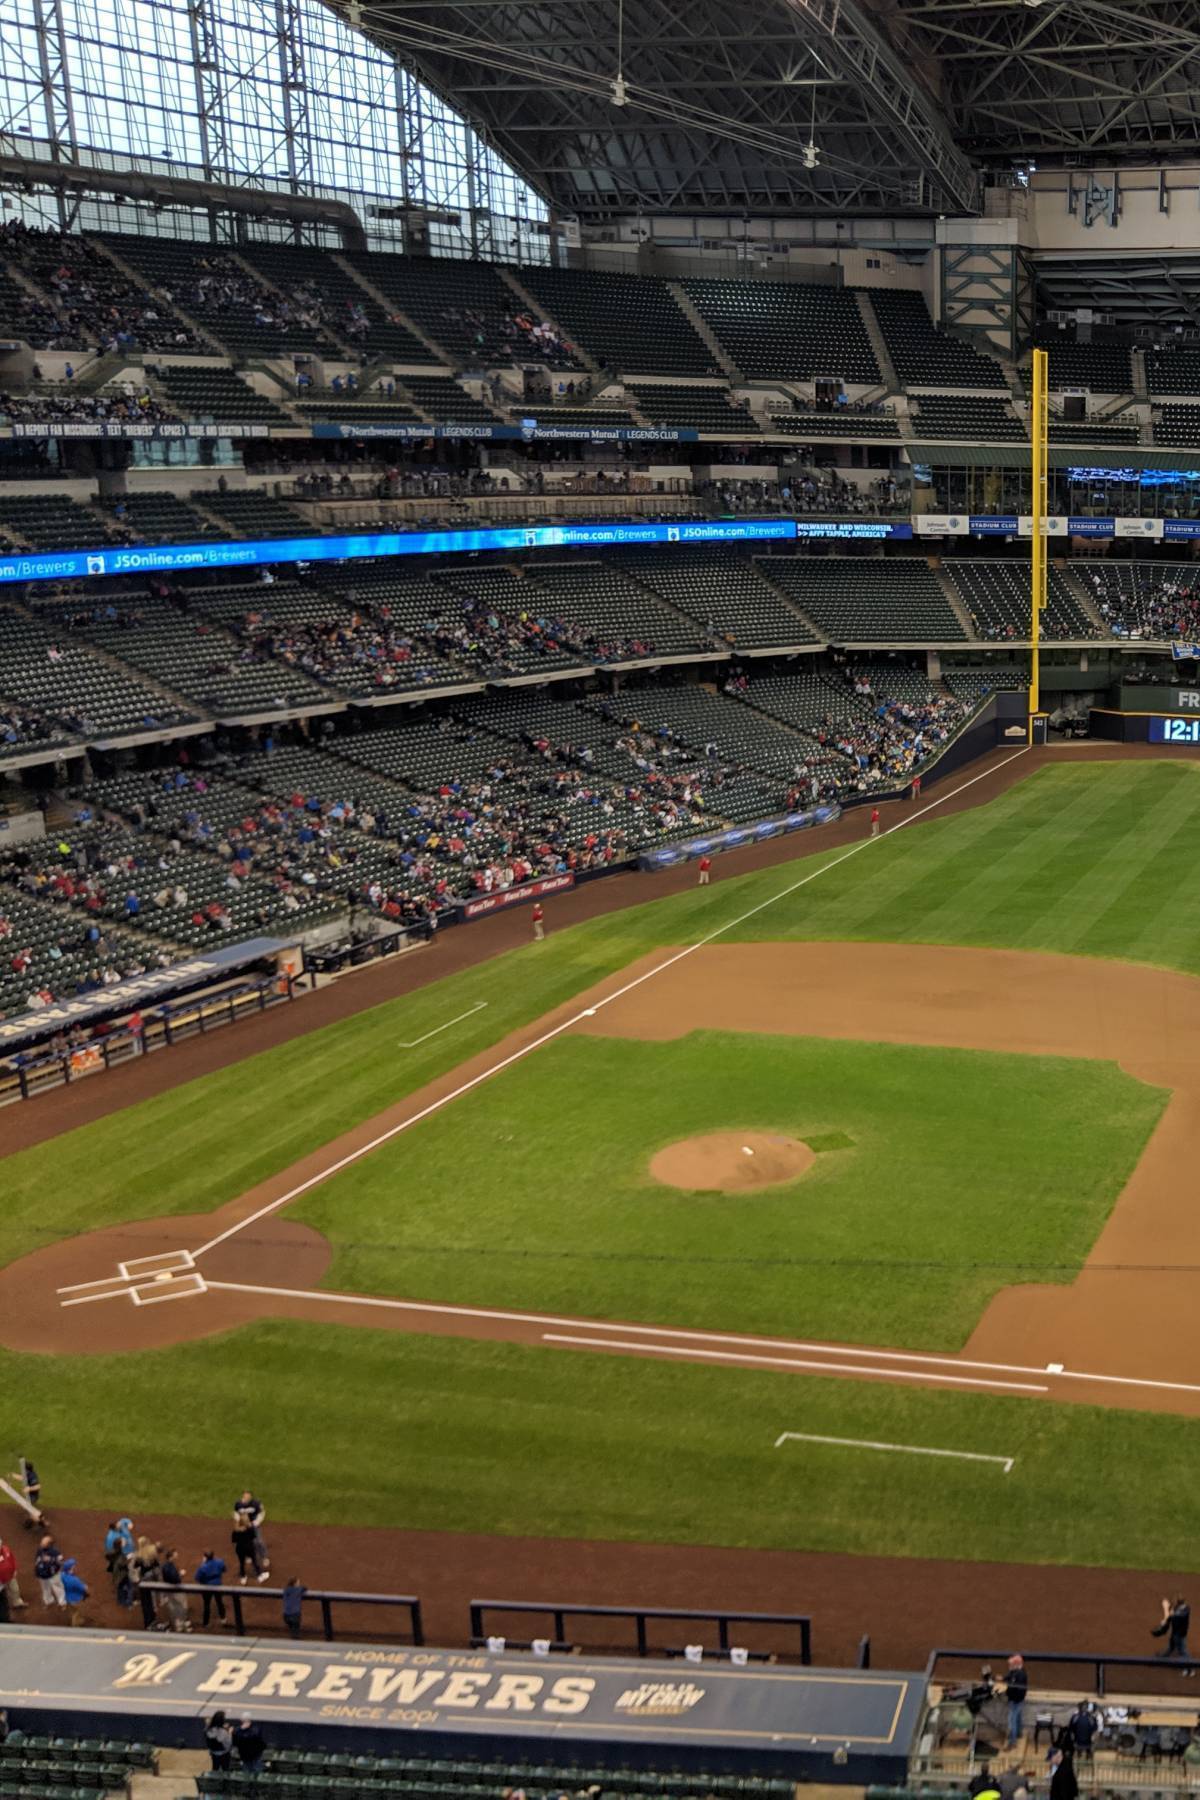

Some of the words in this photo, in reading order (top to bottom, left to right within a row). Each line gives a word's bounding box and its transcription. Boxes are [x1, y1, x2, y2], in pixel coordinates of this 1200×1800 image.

[352, 426, 406, 436] Northwestern
[407, 427, 434, 436] Mutual
[443, 427, 473, 437] LEGENDS
[475, 428, 492, 437] CLUB
[534, 429, 589, 438] Northwestern
[591, 429, 619, 439] Mutual
[627, 430, 659, 439] LEGENDS
[660, 431, 679, 439] CLUB
[343, 1650, 406, 1665] HOME
[412, 1653, 438, 1666] OF
[448, 1656, 488, 1669] THE
[196, 1658, 596, 1714] BREWERS
[319, 1704, 385, 1719] SINCE
[388, 1709, 438, 1723] 2001
